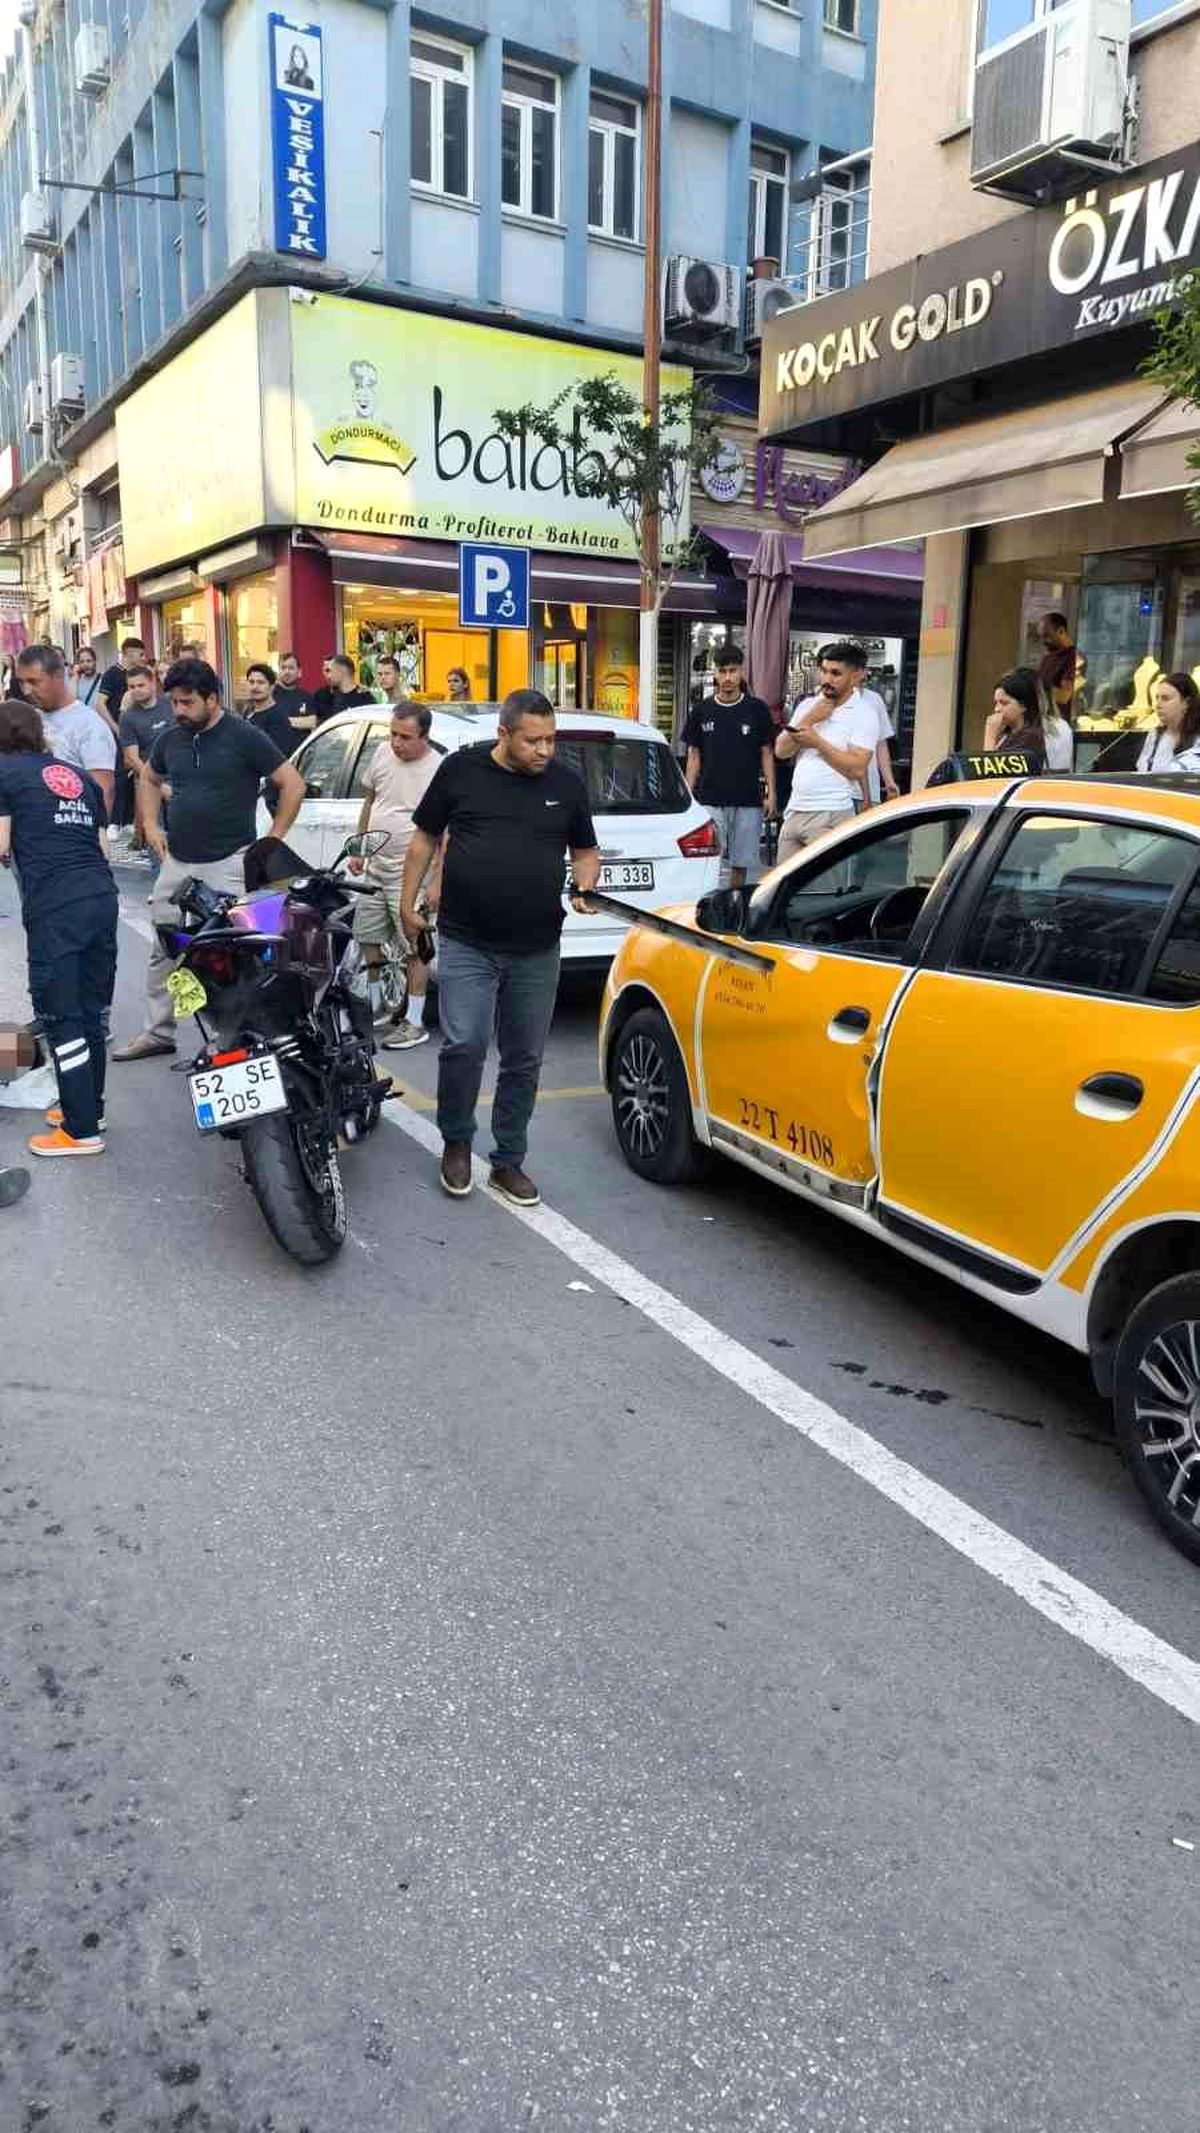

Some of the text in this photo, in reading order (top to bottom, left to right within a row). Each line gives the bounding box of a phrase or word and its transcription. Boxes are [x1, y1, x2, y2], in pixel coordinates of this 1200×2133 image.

[776, 277, 992, 394] KOÇAK GOLD
[317, 500, 429, 530] Dondurma
[474, 554, 512, 616] P
[622, 866, 650, 883] 338
[195, 1060, 276, 1098] 52 SE
[217, 1089, 261, 1118] 205
[739, 1097, 835, 1168] 22 T 4108
